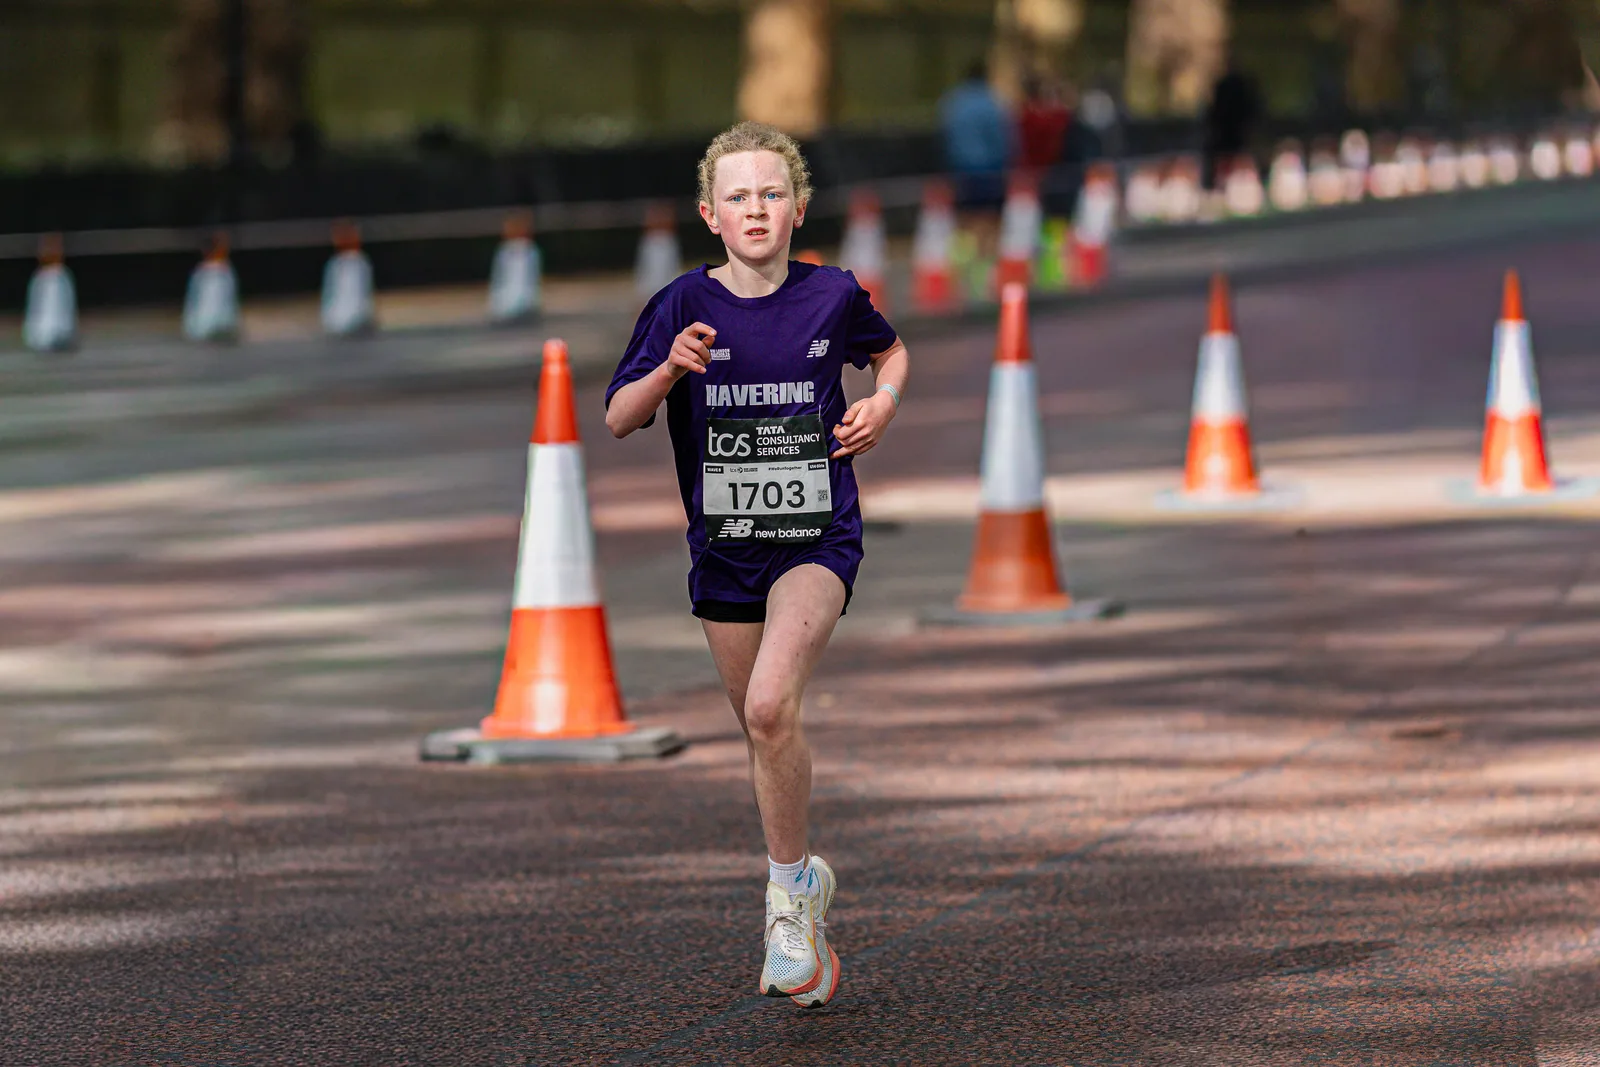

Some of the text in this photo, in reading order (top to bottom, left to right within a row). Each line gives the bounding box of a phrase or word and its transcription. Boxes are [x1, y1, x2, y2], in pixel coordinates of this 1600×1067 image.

[706, 381, 815, 406] HAVERING
[756, 425, 785, 435] TATA
[708, 426, 751, 457] tcs
[756, 433, 820, 446] CONSULTANCY
[756, 445, 800, 456] SERVICES
[728, 479, 805, 510] 1703
[755, 527, 822, 538] new balance
